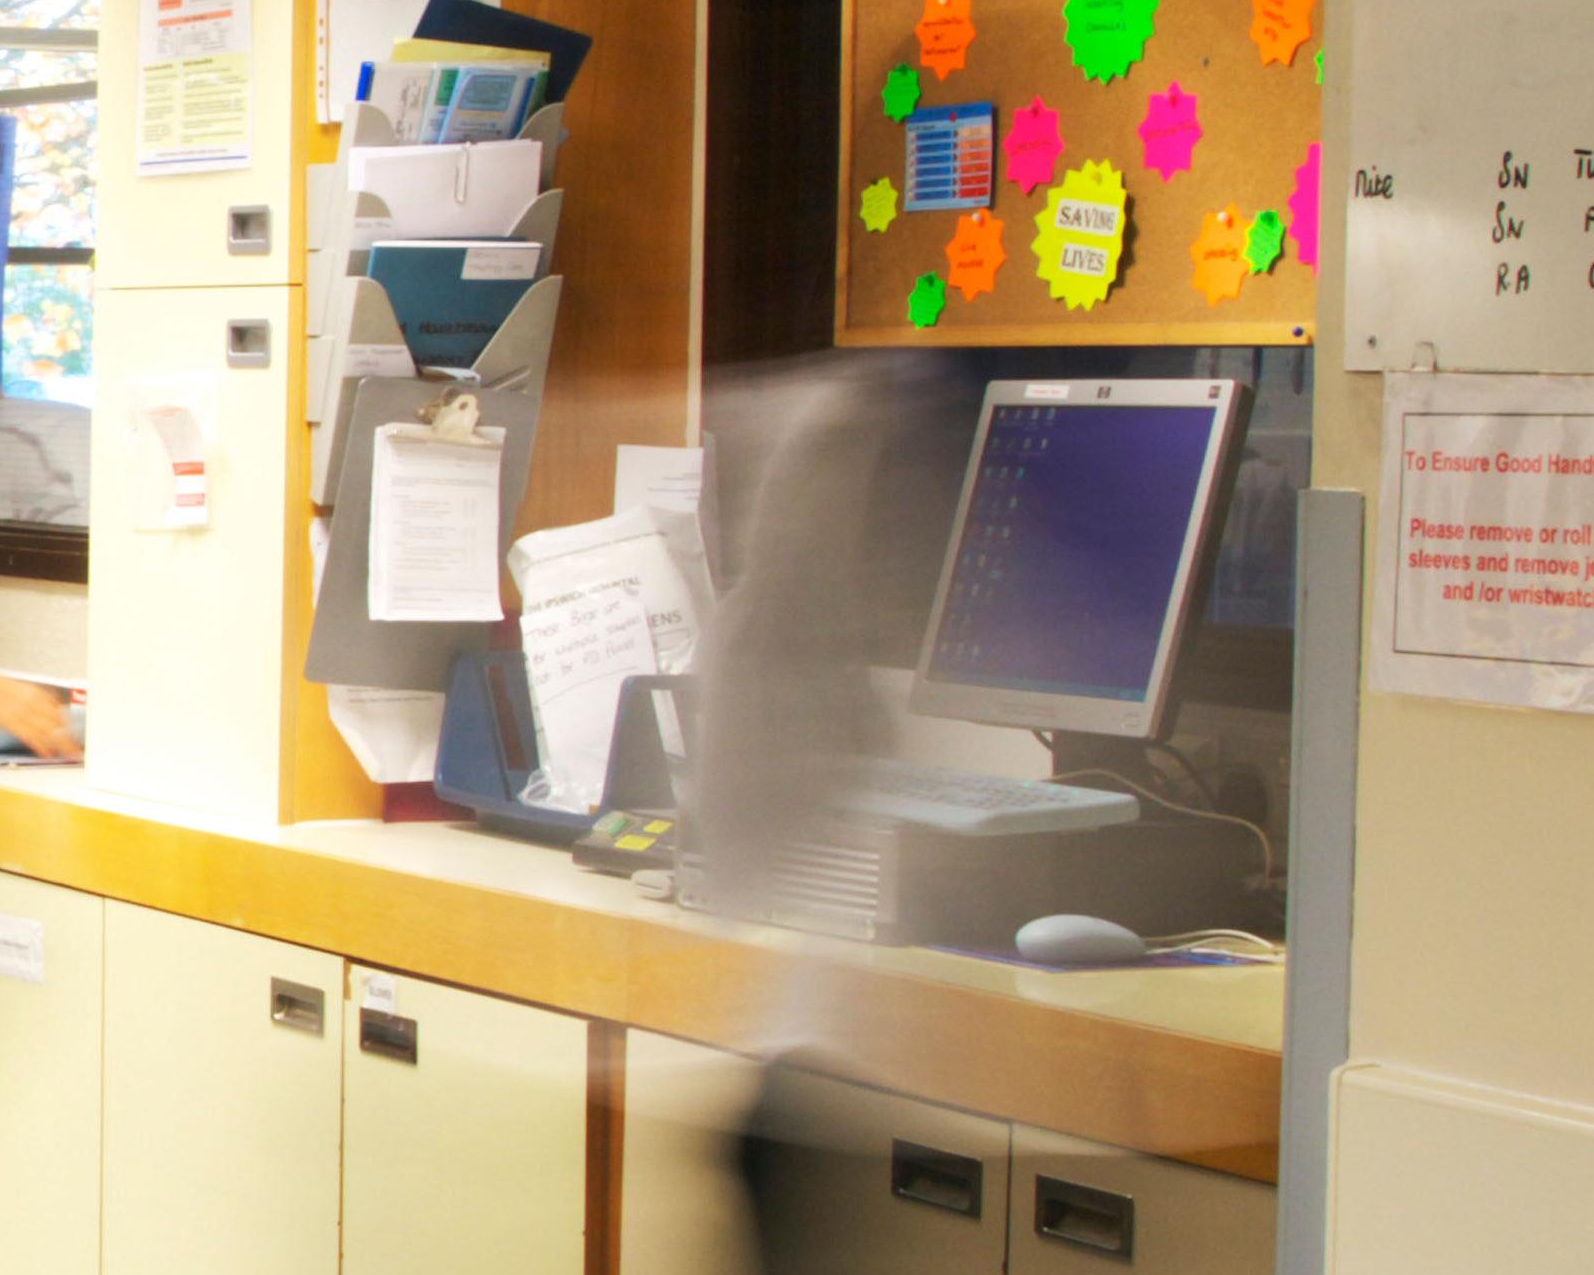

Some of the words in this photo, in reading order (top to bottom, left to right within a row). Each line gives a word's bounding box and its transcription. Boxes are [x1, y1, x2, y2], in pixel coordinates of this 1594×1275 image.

[1059, 205, 1116, 231] SAVING
[1062, 248, 1106, 273] LIVES
[1405, 450, 1427, 472] To
[1431, 451, 1490, 473] Ensure
[1495, 452, 1542, 473] Good
[1548, 453, 1594, 475] Hand
[1409, 518, 1464, 541] Please
[1469, 525, 1533, 543] remove
[1539, 526, 1558, 544] or
[1563, 523, 1592, 545] roll
[1408, 549, 1471, 571] sleeves
[1476, 551, 1509, 573] and
[1514, 556, 1579, 576] remove
[1443, 581, 1473, 601] and
[1508, 584, 1594, 608] wristwatc
